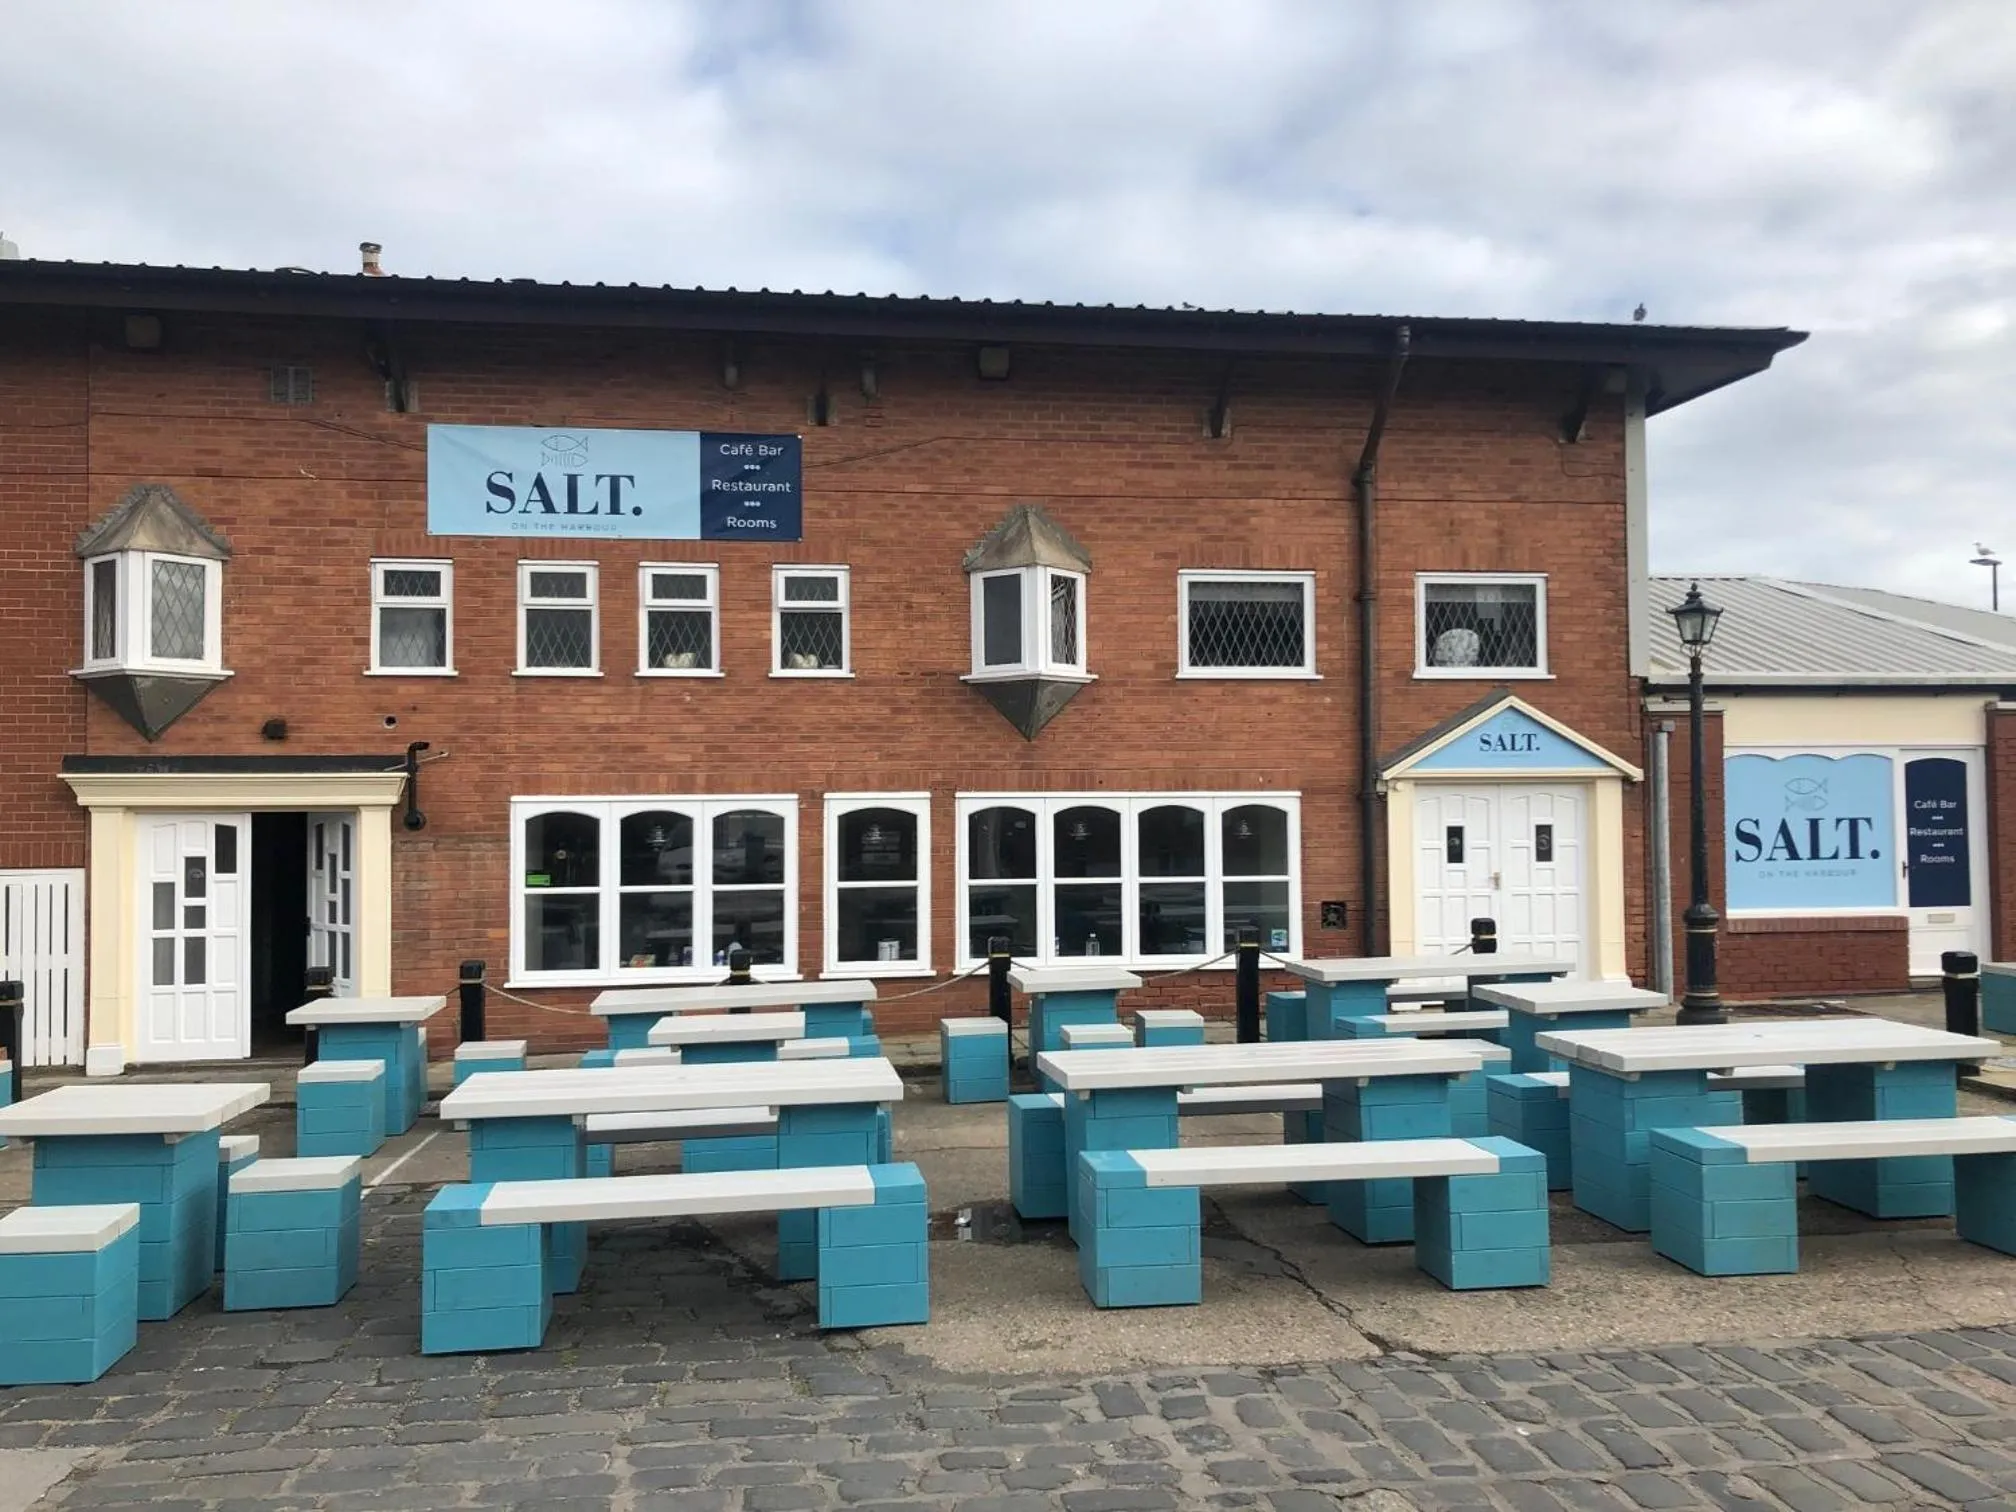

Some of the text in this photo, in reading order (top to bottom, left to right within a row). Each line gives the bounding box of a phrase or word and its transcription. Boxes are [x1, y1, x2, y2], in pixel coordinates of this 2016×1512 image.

[720, 443, 784, 456] Café Bar
[711, 479, 791, 493] Restaurant
[486, 471, 643, 517] SALT.
[726, 516, 777, 529] Rooms
[1479, 733, 1541, 752] SALT.
[1914, 800, 1957, 809] Café Bar
[1909, 827, 1964, 836] Restaurant
[1735, 817, 1881, 862] SALT.
[1920, 854, 1955, 864] Rooms
